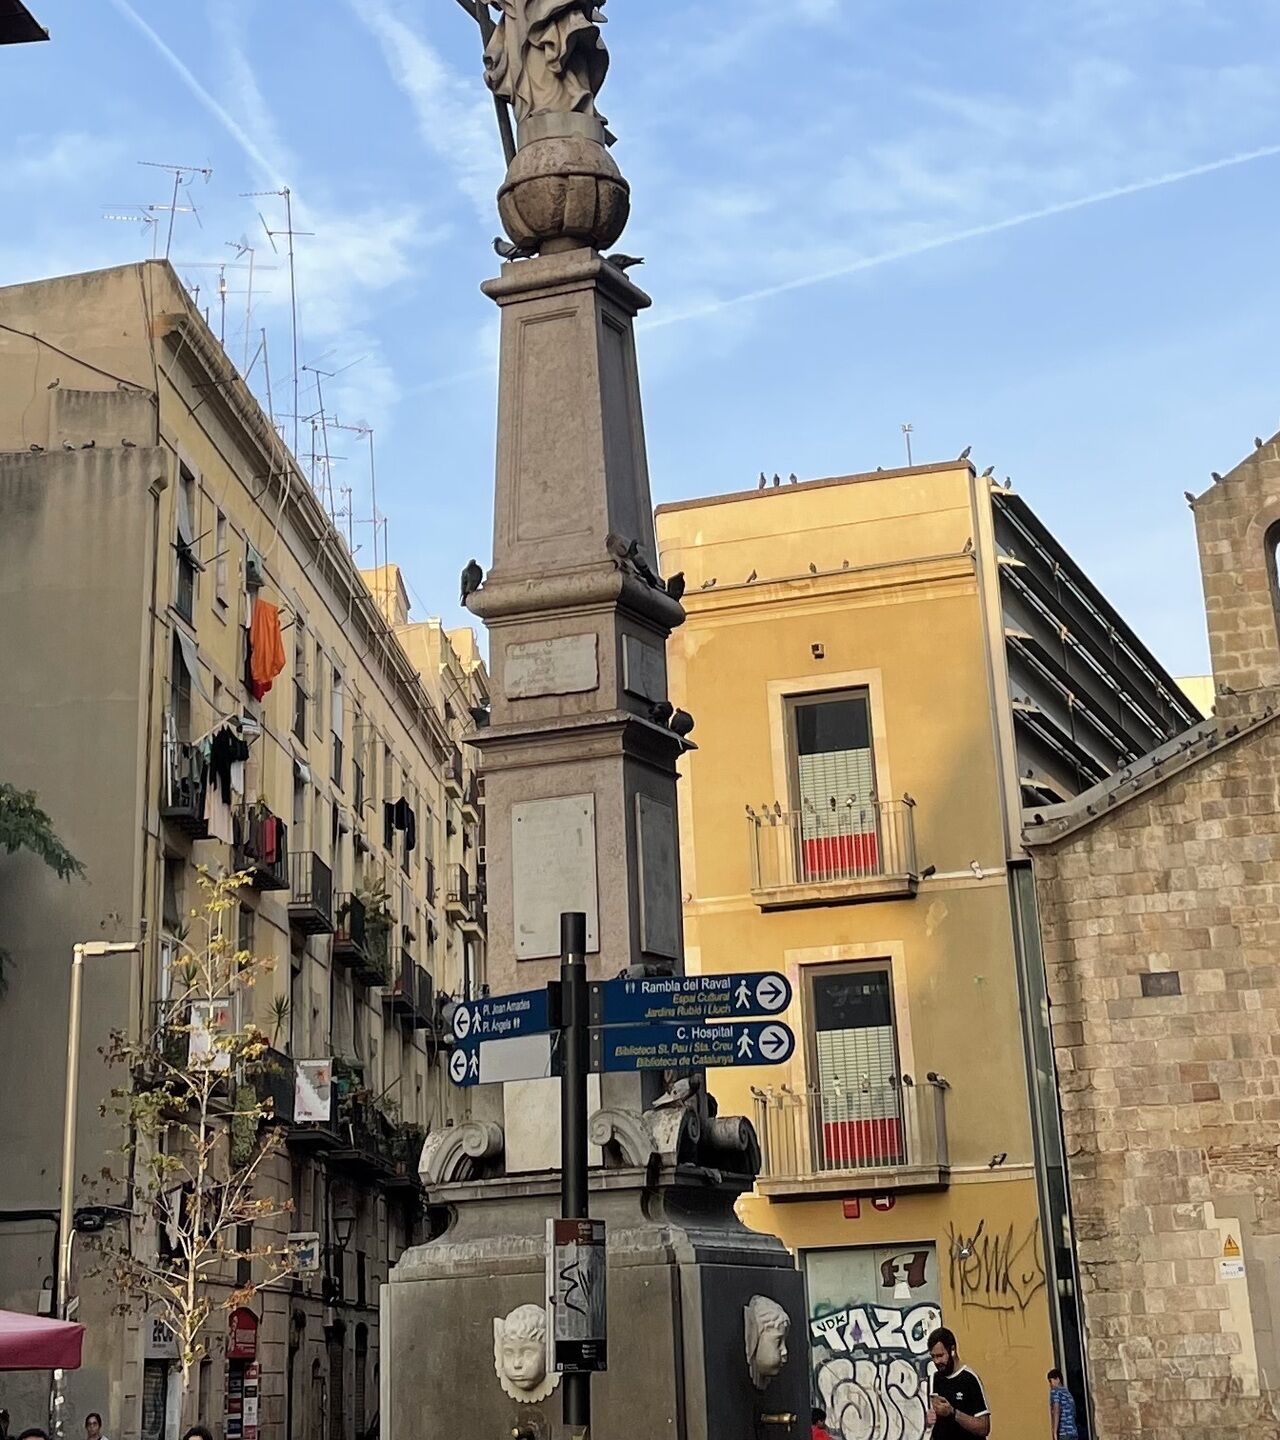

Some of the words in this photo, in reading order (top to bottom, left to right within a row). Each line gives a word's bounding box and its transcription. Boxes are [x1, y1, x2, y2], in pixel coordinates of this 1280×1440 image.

[641, 980, 680, 993] Rambla
[683, 978, 699, 991] del
[701, 976, 731, 990] Raval
[672, 992, 696, 1004] Espai
[697, 991, 730, 1003] Cultural
[492, 1003, 506, 1015] Joan
[645, 1006, 676, 1018] Jardins
[677, 1027, 689, 1039] C.
[691, 1025, 733, 1040] Hospital
[615, 1045, 656, 1056] Biblioteca
[671, 1043, 688, 1054] Pau
[712, 1040, 733, 1051] Creu
[636, 1056, 678, 1068] Biblioteca
[679, 1056, 690, 1065] de
[692, 1054, 734, 1066] Catalunya
